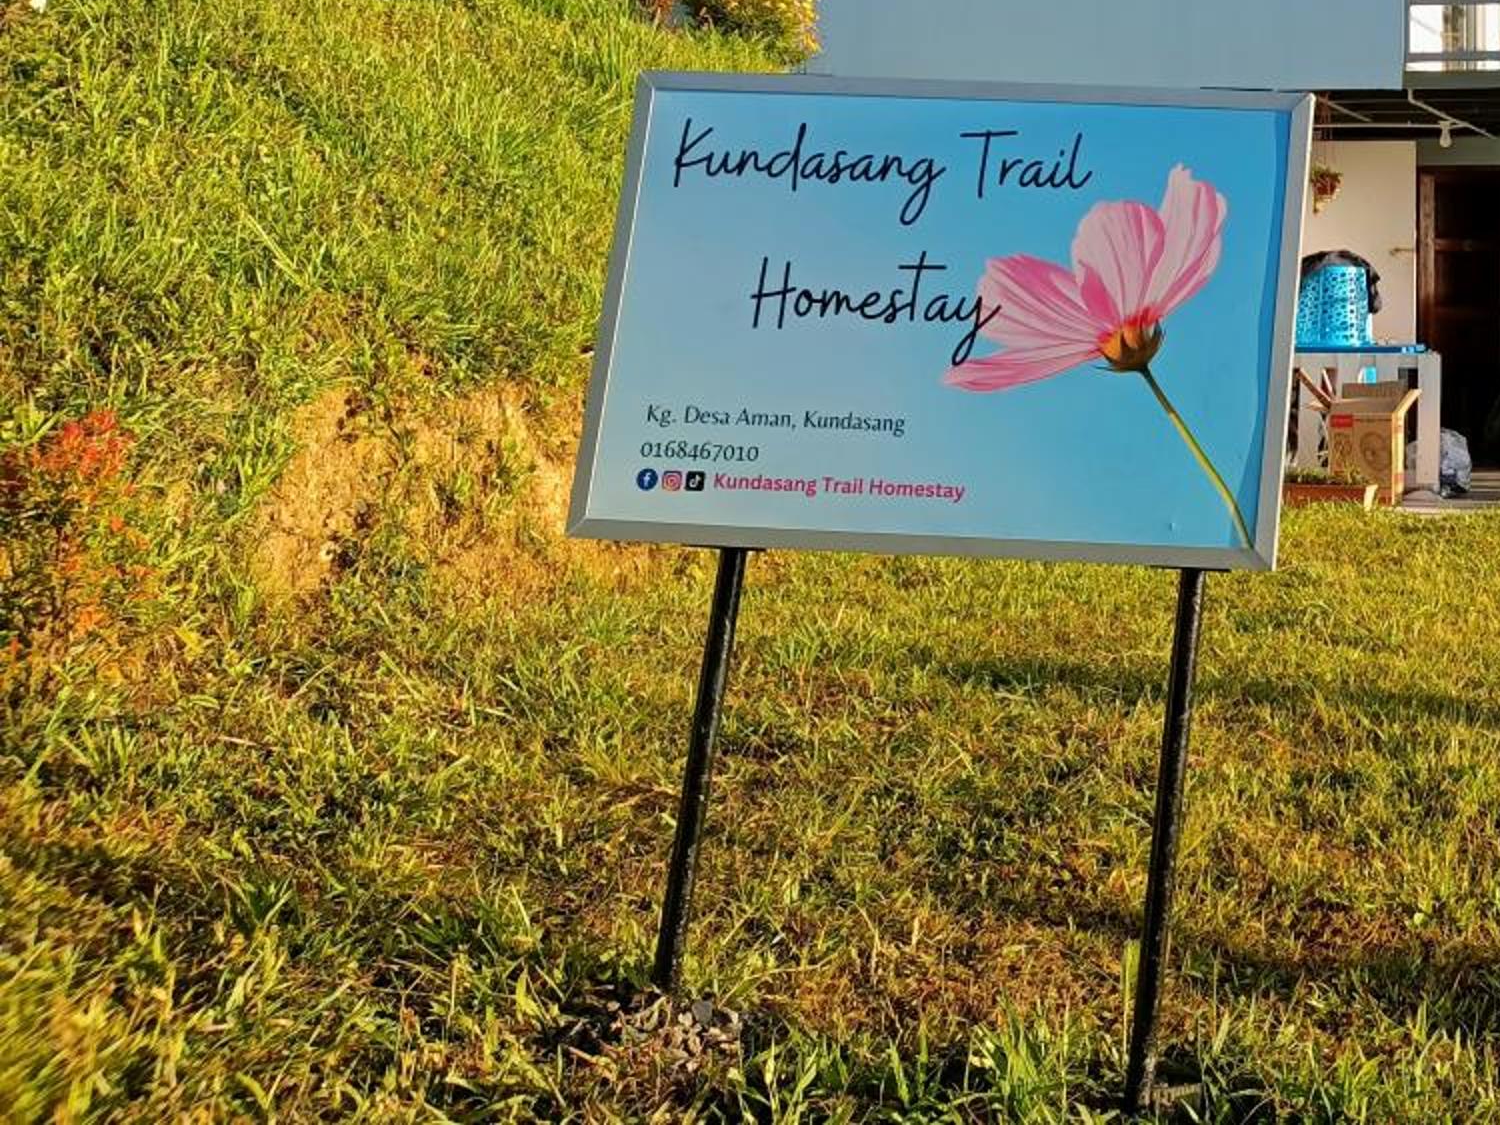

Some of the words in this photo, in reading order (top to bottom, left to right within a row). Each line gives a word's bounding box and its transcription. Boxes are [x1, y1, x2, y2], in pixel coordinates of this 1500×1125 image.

[673, 118, 947, 225] Kundasang
[960, 130, 1093, 199] Trail
[751, 251, 1002, 367] Homestay
[648, 404, 676, 428] Kg.
[684, 405, 731, 425] Desa
[735, 408, 797, 430] Aman,
[803, 410, 906, 437] Kundasang
[640, 440, 760, 463] 0168467010
[713, 473, 817, 497] Kundasang
[822, 476, 864, 495] Trail
[869, 478, 965, 503] Homestay
